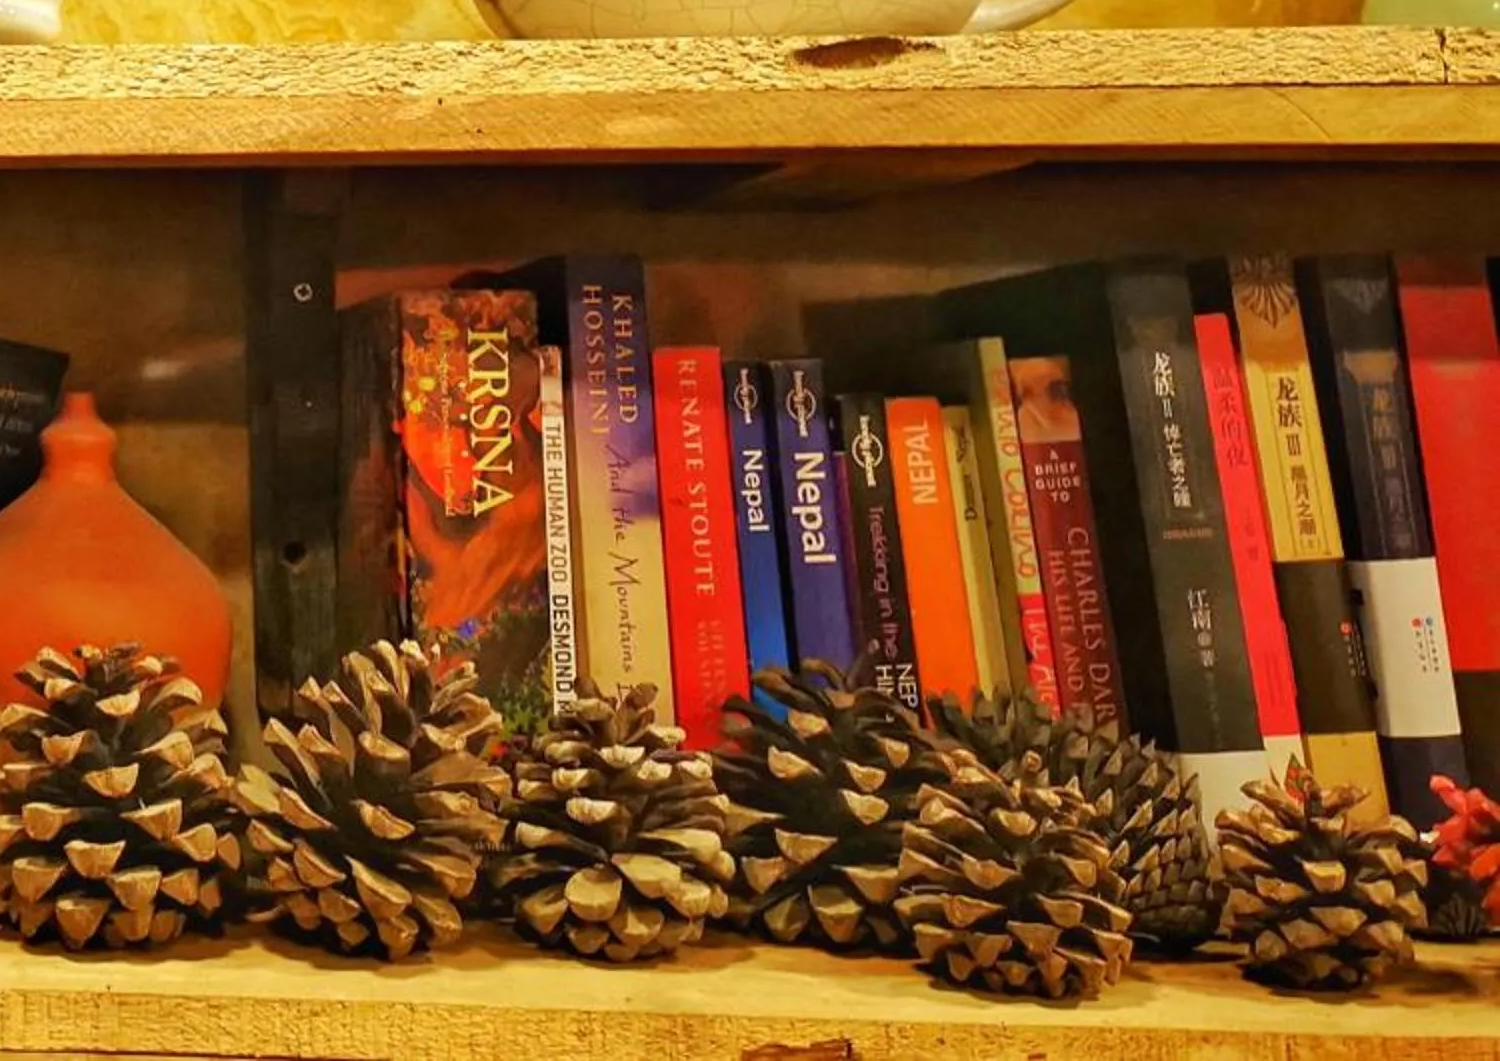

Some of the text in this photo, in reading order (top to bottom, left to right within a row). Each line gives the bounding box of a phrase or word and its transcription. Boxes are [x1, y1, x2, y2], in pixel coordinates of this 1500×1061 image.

[581, 285, 610, 434] HOSSEINI
[611, 294, 639, 424] KHALED
[1276, 376, 1303, 429] 龙族
[545, 423, 563, 461] THE
[676, 359, 705, 471] RENATE
[547, 467, 568, 537] HUMAN
[739, 448, 771, 532] Nepal
[903, 419, 940, 506] NEPAL
[1034, 462, 1078, 477] BRIEF
[1034, 476, 1082, 490] GUIDE
[1050, 491, 1071, 503] TO
[687, 480, 716, 596] STOUTE
[790, 451, 838, 565] Nepal
[549, 544, 568, 583] ZOO
[551, 594, 575, 694] DESMOND
[607, 550, 642, 674] Mountains
[1049, 550, 1069, 587] HIS
[1060, 641, 1085, 692] AND
[1067, 526, 1118, 723] CHARLES DAR
[895, 662, 920, 710] NEP
